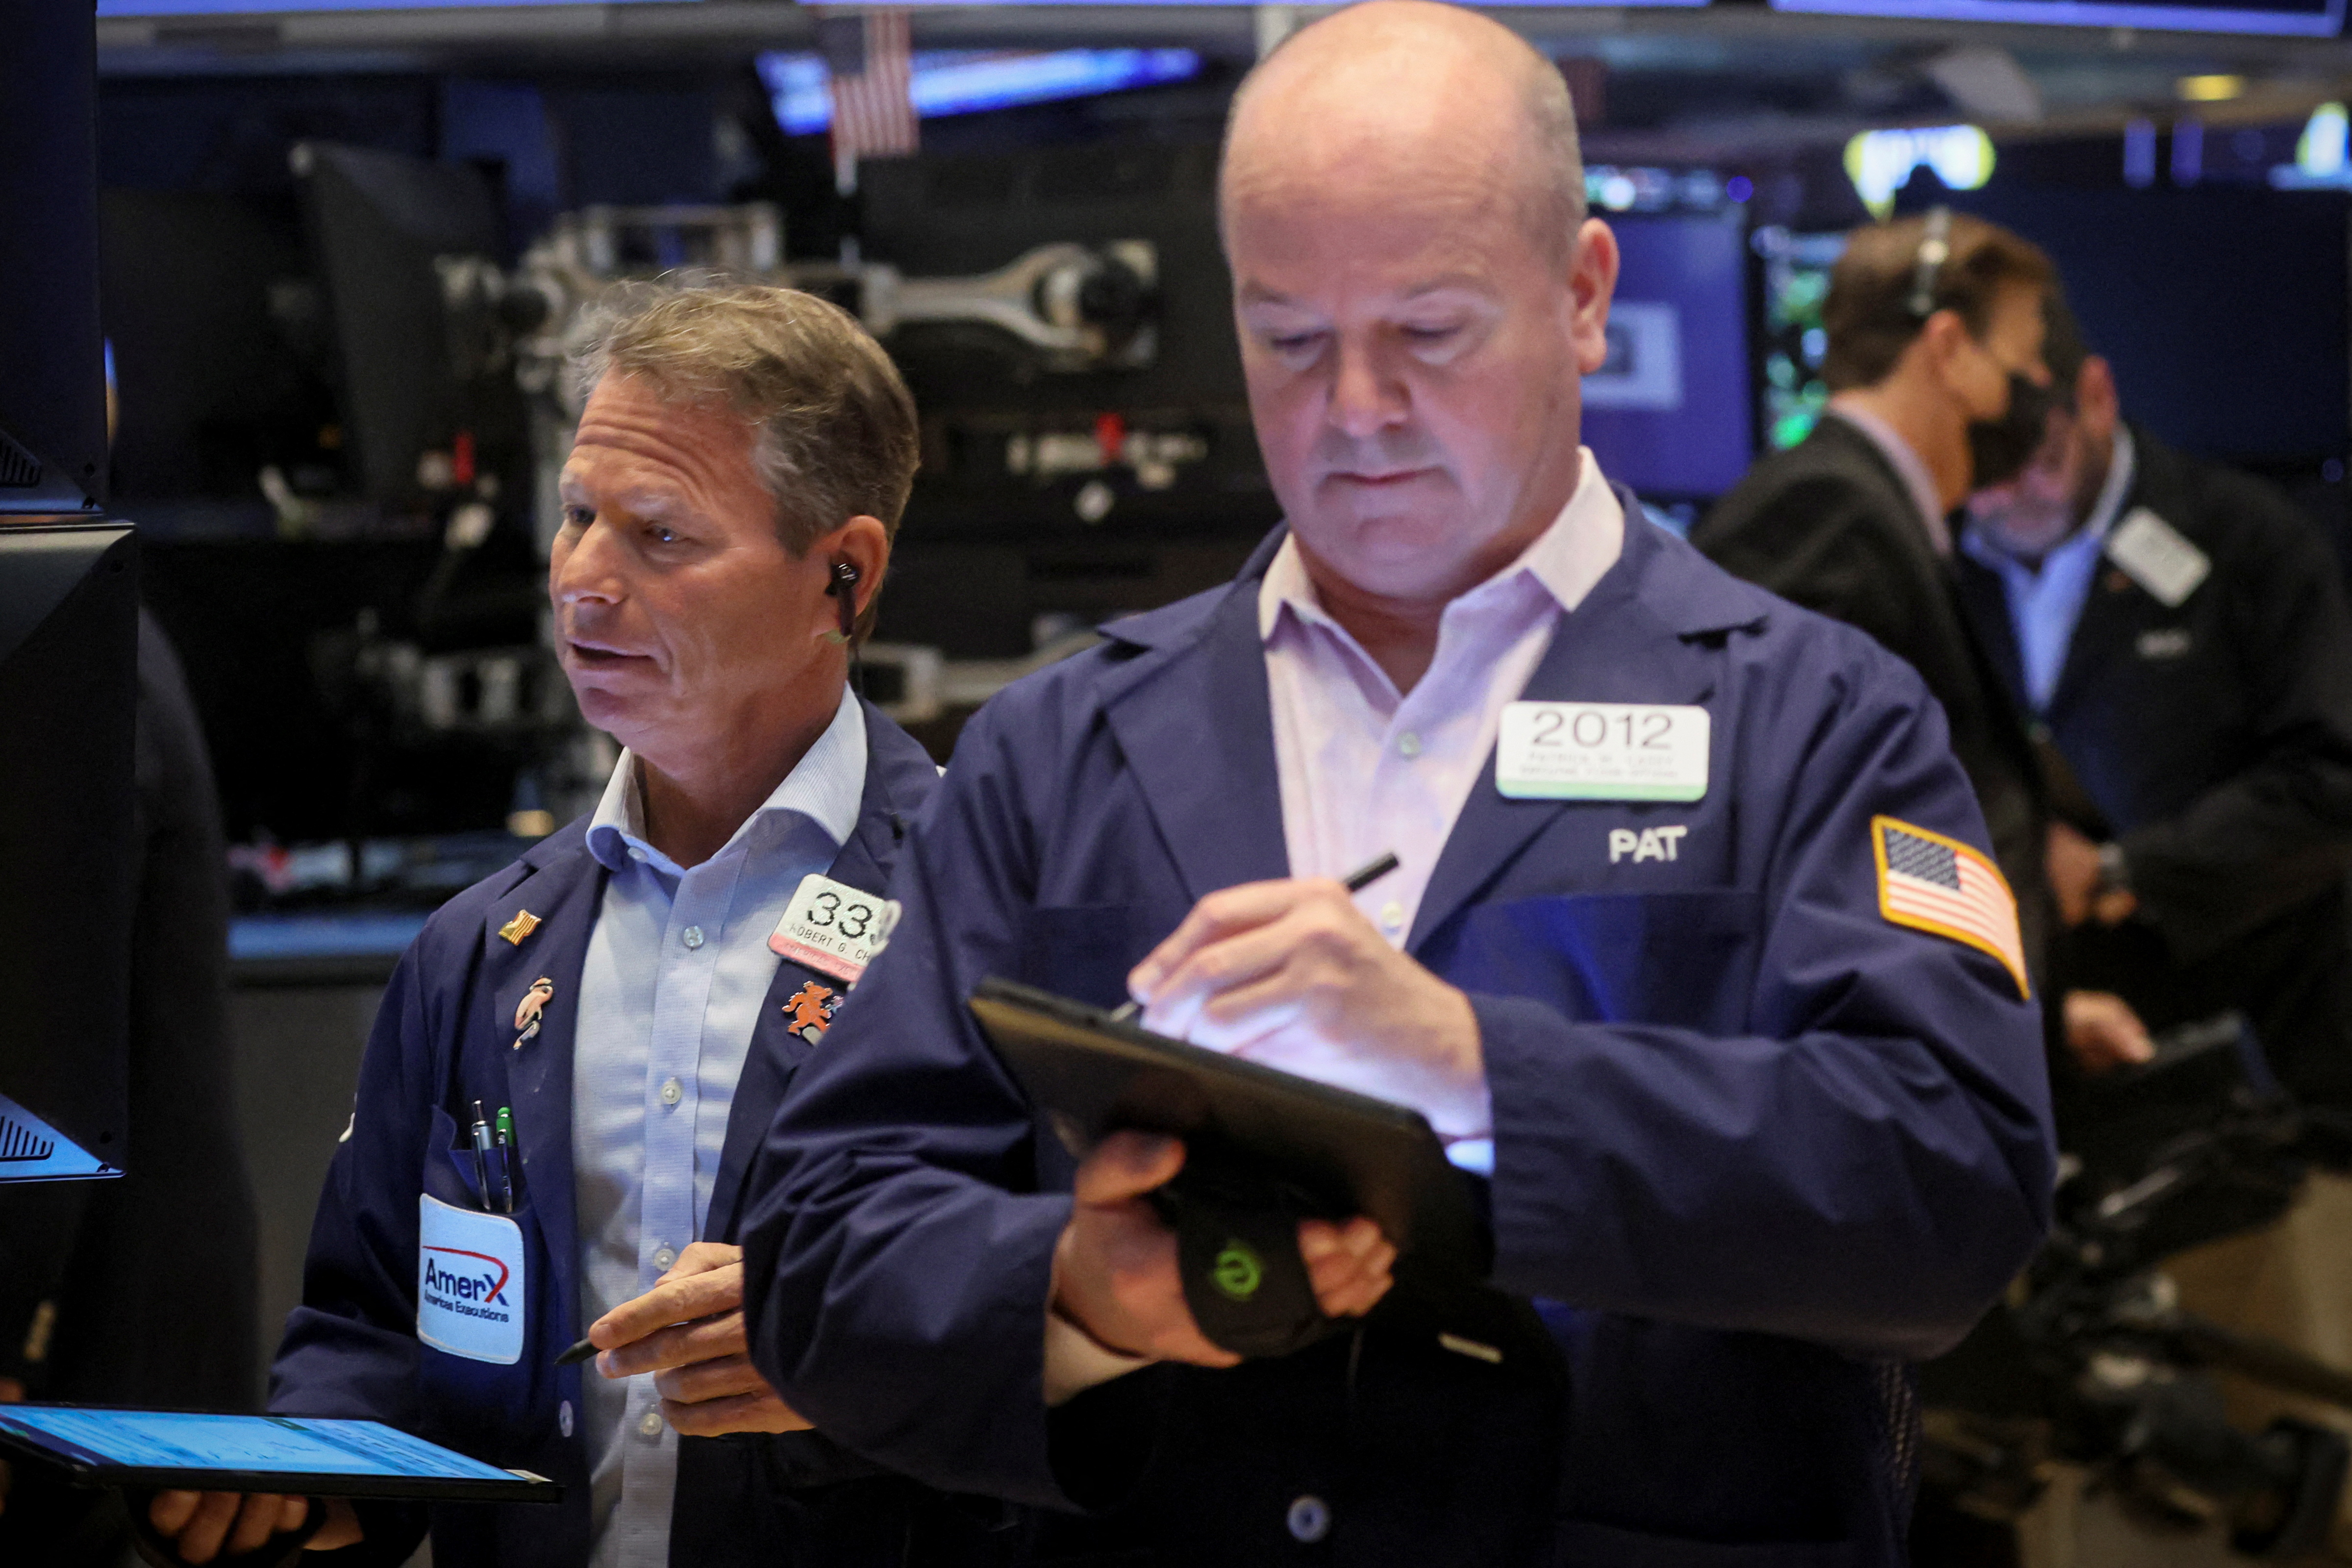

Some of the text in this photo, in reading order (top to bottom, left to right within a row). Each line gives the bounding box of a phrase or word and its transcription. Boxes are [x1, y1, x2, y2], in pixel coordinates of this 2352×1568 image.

[1532, 709, 1673, 750] 2012
[1609, 825, 1687, 863] PAT
[789, 923, 833, 947] ROBERT
[807, 892, 878, 946] 33
[425, 1257, 509, 1307] AmerX
